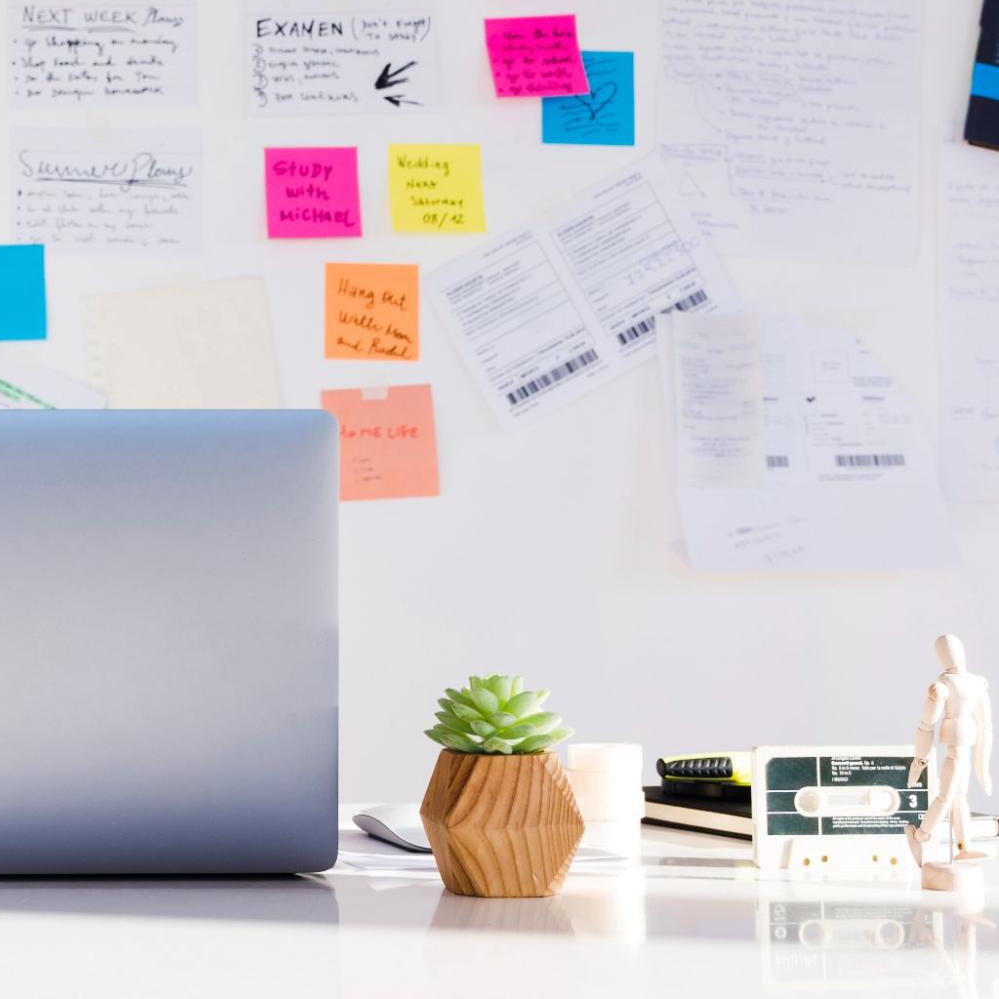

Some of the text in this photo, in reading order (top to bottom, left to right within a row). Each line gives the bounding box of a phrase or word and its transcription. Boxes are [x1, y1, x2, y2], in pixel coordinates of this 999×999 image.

[84, 10, 137, 25] WEEK
[256, 17, 344, 38] EXAMEN
[286, 183, 330, 200] with
[908, 794, 918, 808] 3
